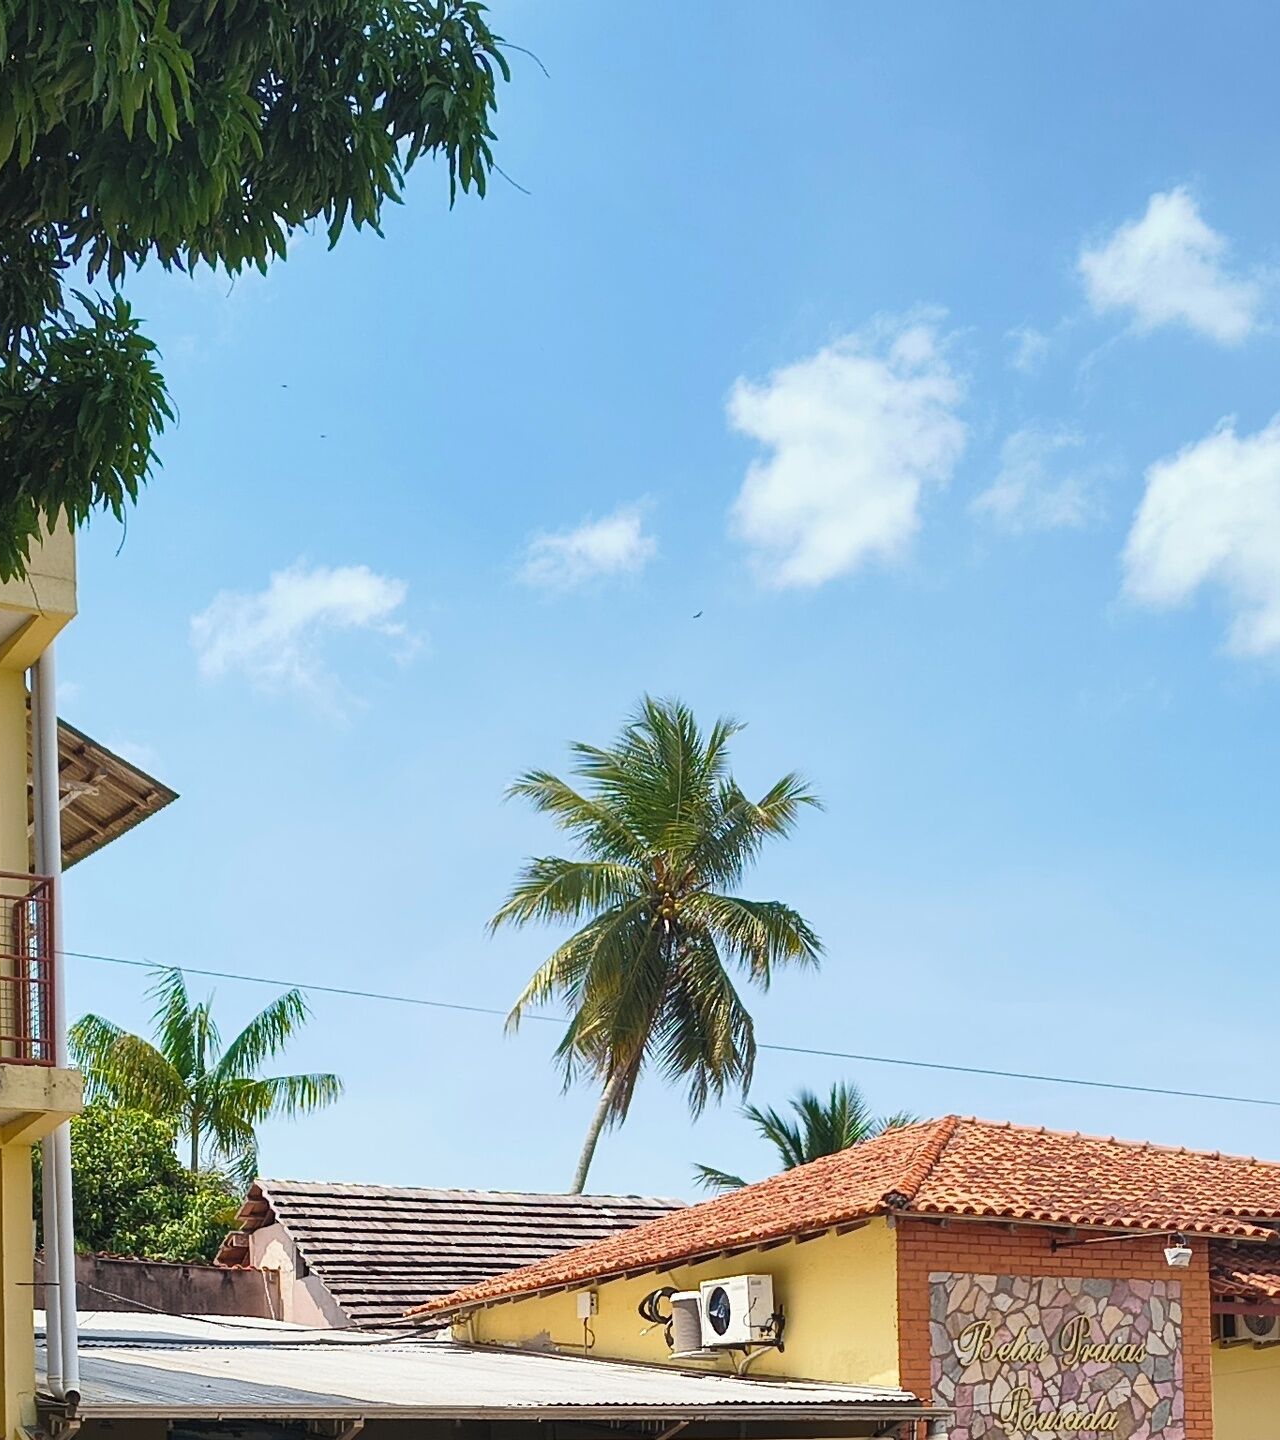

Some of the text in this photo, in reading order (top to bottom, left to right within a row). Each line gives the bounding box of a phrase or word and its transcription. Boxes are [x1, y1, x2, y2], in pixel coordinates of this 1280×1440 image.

[958, 1313, 1148, 1366] Belas Praias
[1000, 1385, 1120, 1436] Pousada
